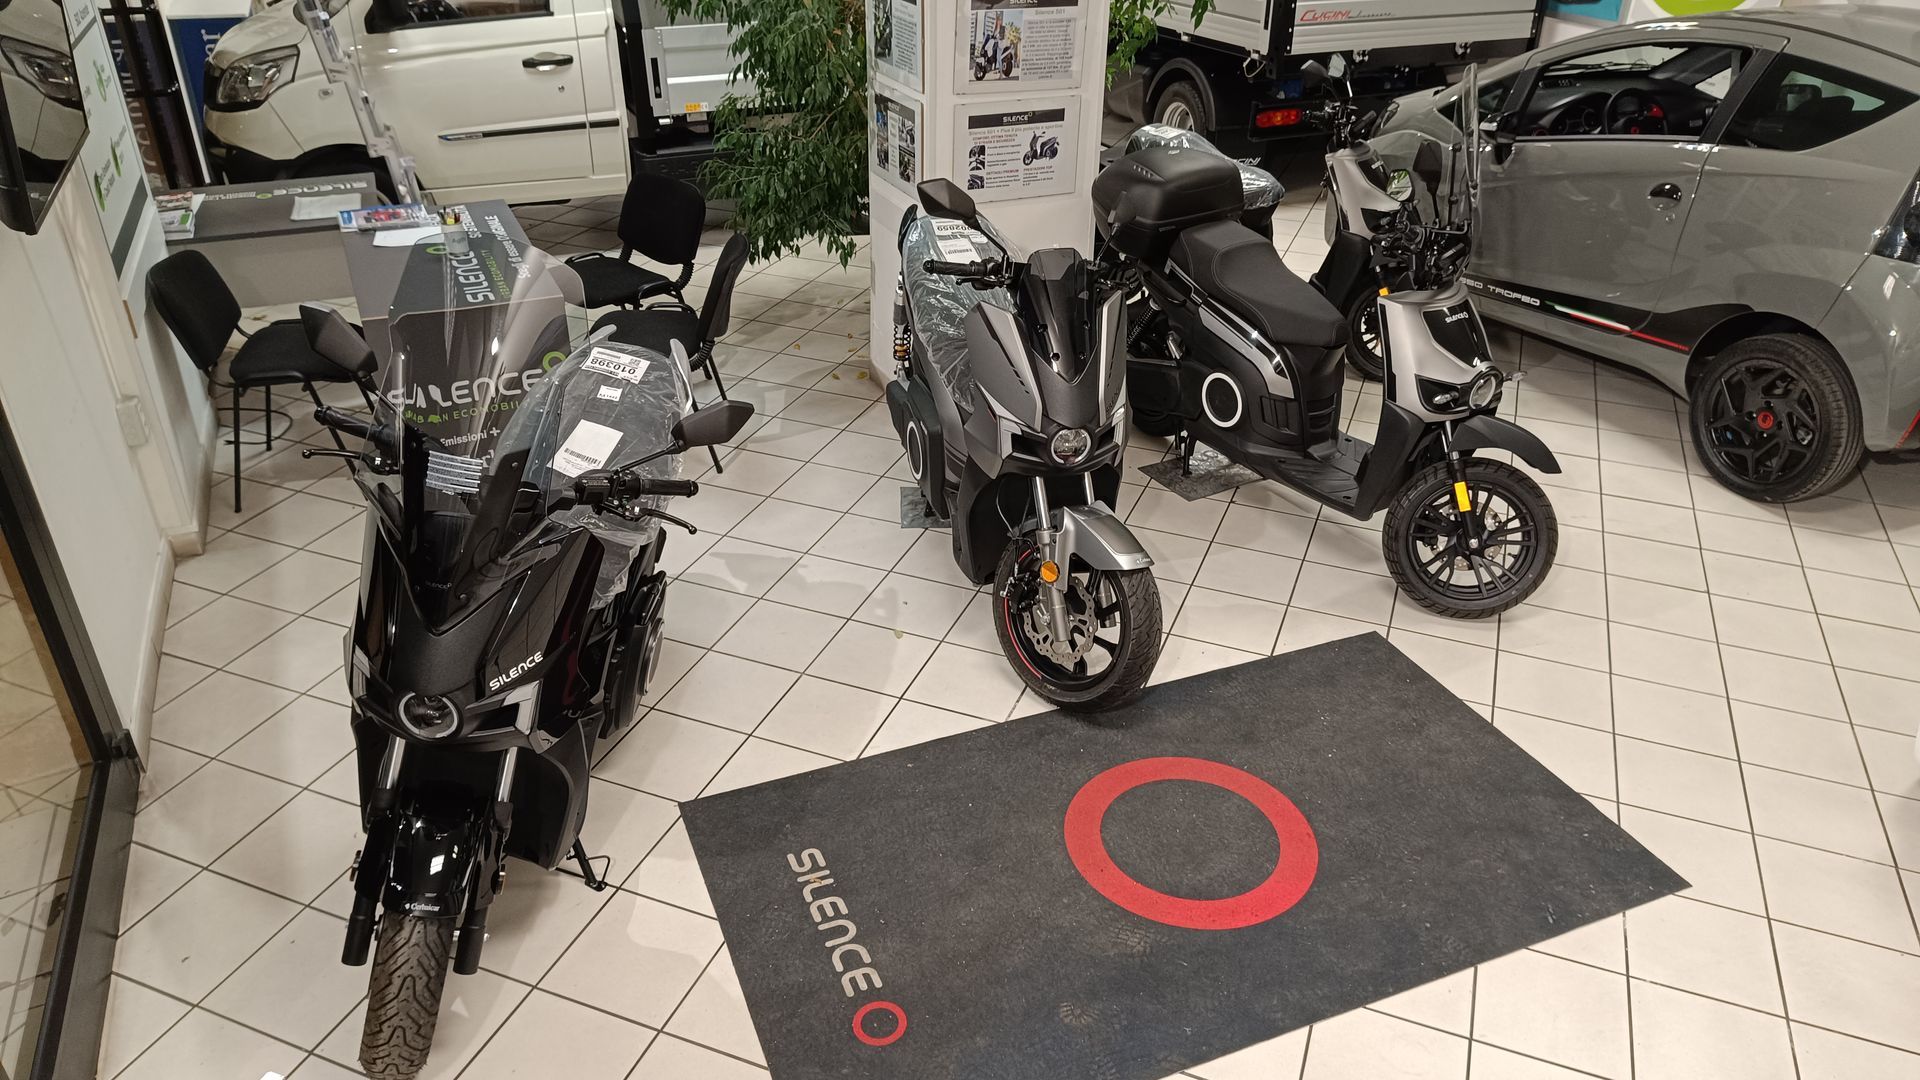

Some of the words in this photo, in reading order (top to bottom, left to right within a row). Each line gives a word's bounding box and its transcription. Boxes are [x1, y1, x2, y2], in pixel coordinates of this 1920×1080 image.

[1002, 113, 1029, 123] SILENCE
[1486, 285, 1541, 307] TROFEO
[590, 356, 637, 379] 010398
[489, 651, 544, 691] SILENCE
[786, 847, 883, 998] SILENCE
